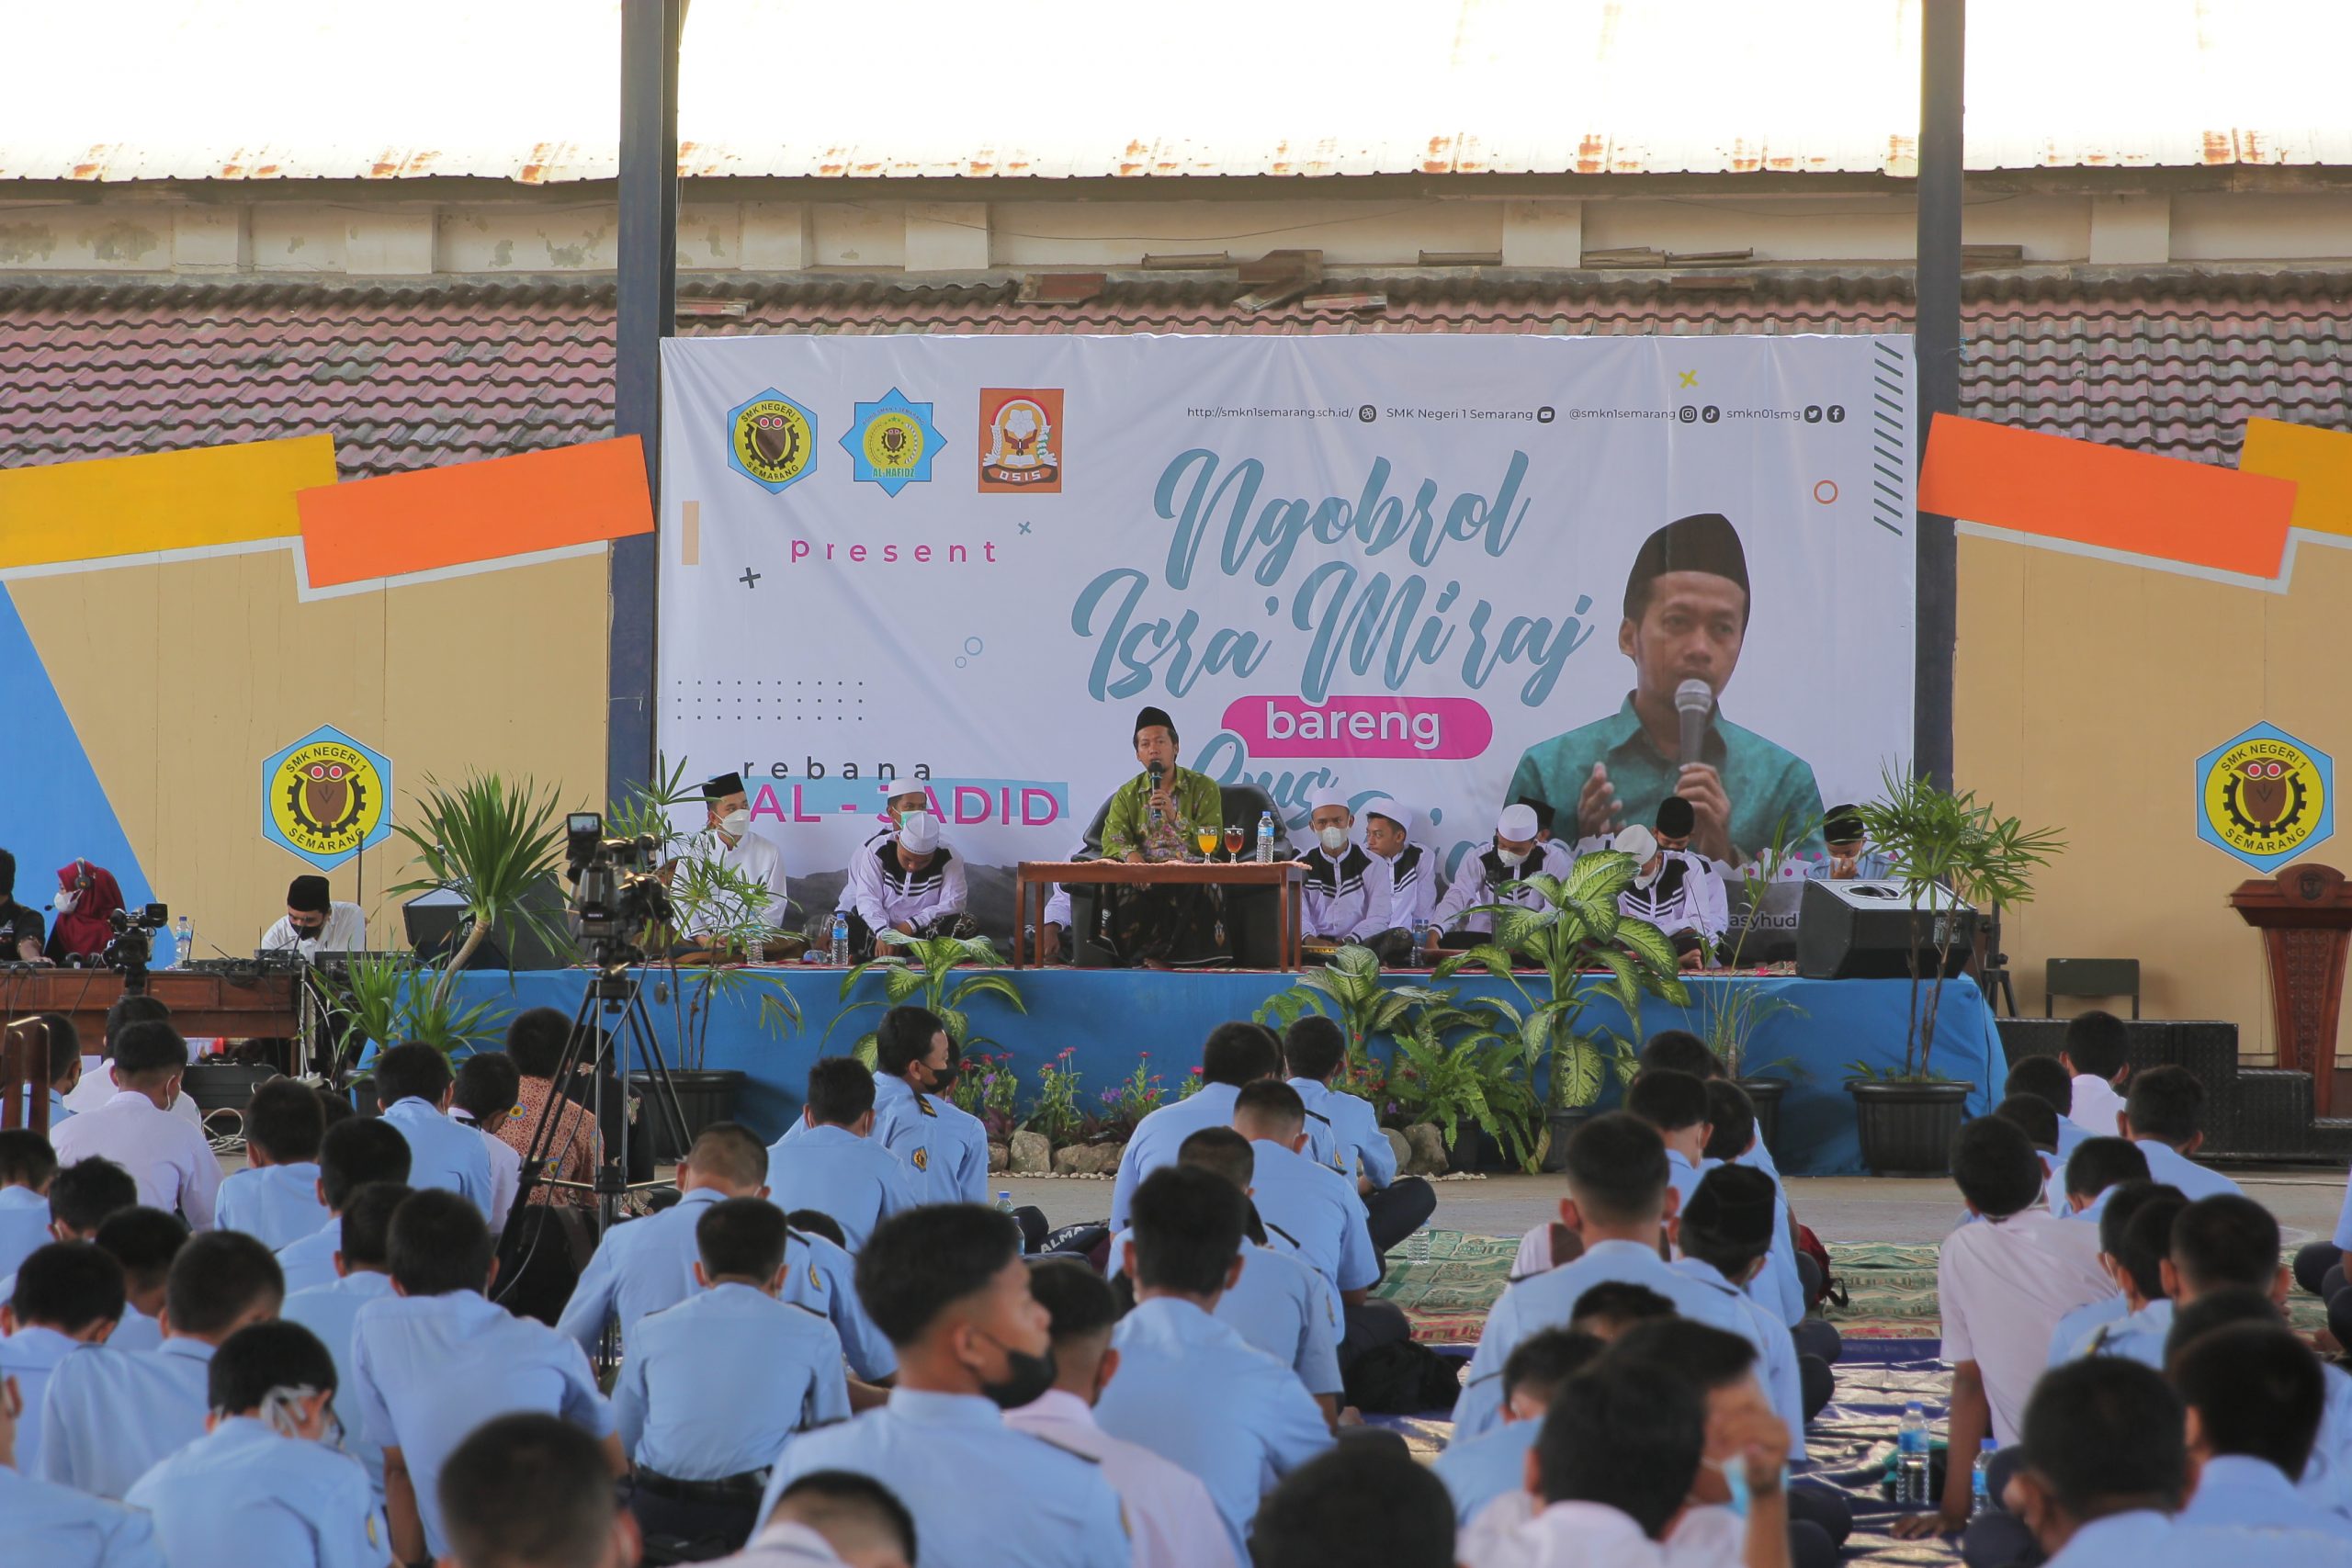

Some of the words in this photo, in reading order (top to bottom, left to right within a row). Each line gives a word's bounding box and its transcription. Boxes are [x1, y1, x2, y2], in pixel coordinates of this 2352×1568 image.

[741, 407, 760, 423] SMK
[761, 402, 796, 417] NEGERI
[1187, 406, 1353, 420] http://smkn1semarang.sch.id/
[1385, 408, 1415, 419] SMK
[1418, 408, 1459, 422] Negeri
[1461, 409, 1467, 419] 1
[1469, 409, 1533, 422] Semarang
[1568, 408, 1677, 421] @smkn1semarang
[1726, 408, 1801, 421] smkn01smg
[746, 461, 799, 480] SEMARANG
[872, 467, 915, 478] AL-HAFIDZ
[999, 469, 1042, 481] OSIS
[1154, 448, 1532, 591] Ngobrol
[791, 539, 997, 563] present
[1266, 701, 1441, 750] bareng
[286, 750, 311, 773] SMK
[313, 746, 360, 766] NEGERI
[743, 756, 931, 781] rebana
[2221, 749, 2247, 772] SMK
[2249, 743, 2300, 762] NEGERI
[750, 784, 821, 823] AL
[2225, 827, 2306, 851] SEMARANG
